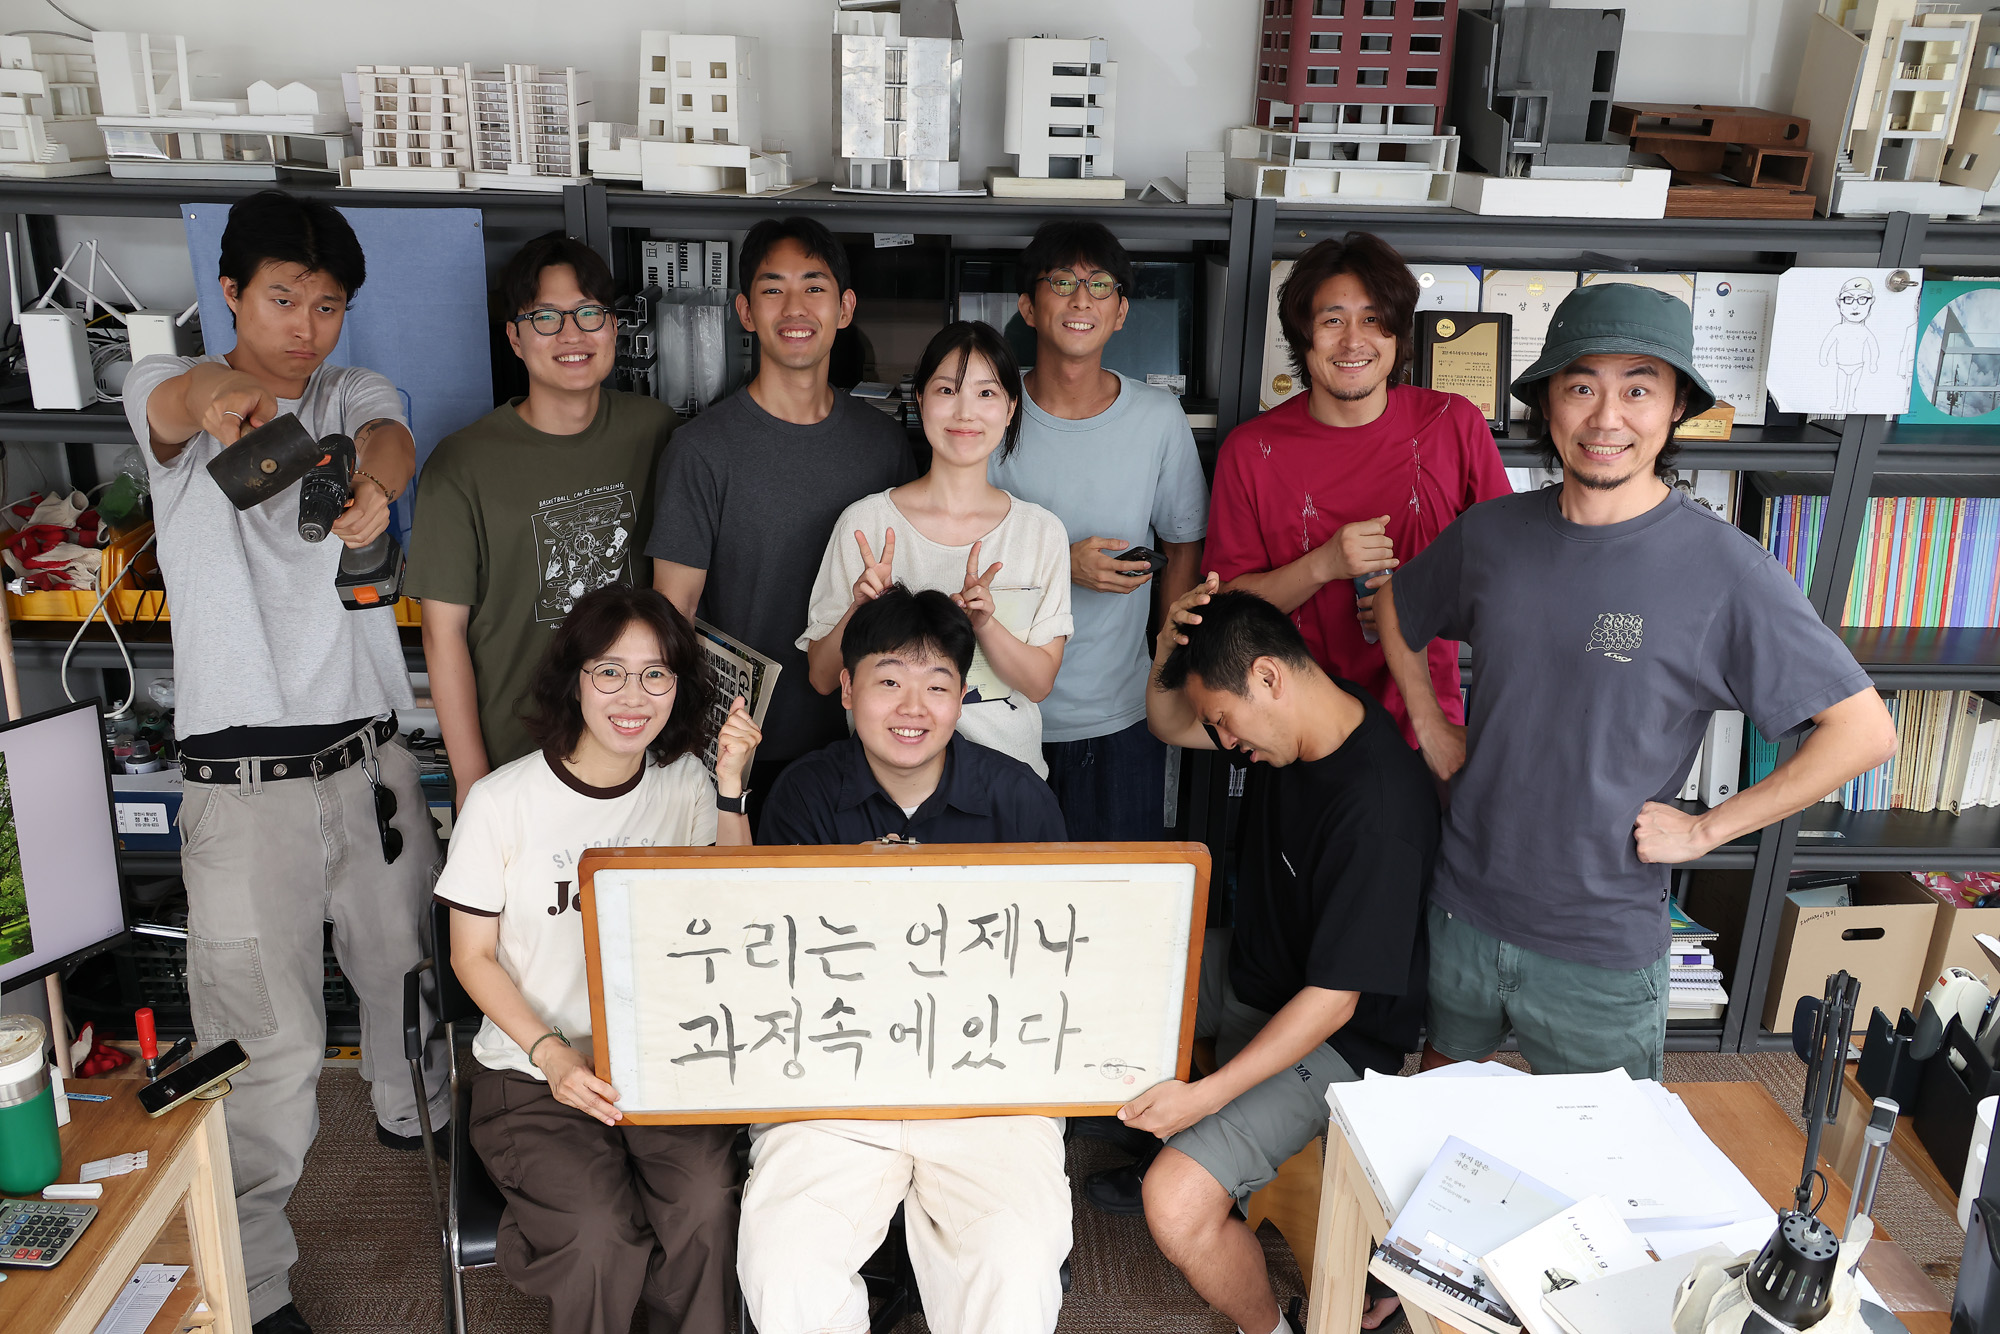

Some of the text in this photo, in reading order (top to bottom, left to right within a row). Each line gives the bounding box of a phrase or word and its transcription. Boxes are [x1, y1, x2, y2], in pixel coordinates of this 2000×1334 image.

[712, 252, 722, 286] REHAU
[1518, 302, 1551, 312] 상 장
[1708, 309, 1735, 318] 상 장
[539, 494, 570, 508] BASKETBALL
[593, 481, 625, 493] CONFUSING
[667, 903, 1090, 990] 우리는 언제나
[1568, 1216, 1608, 1269] ludwig
